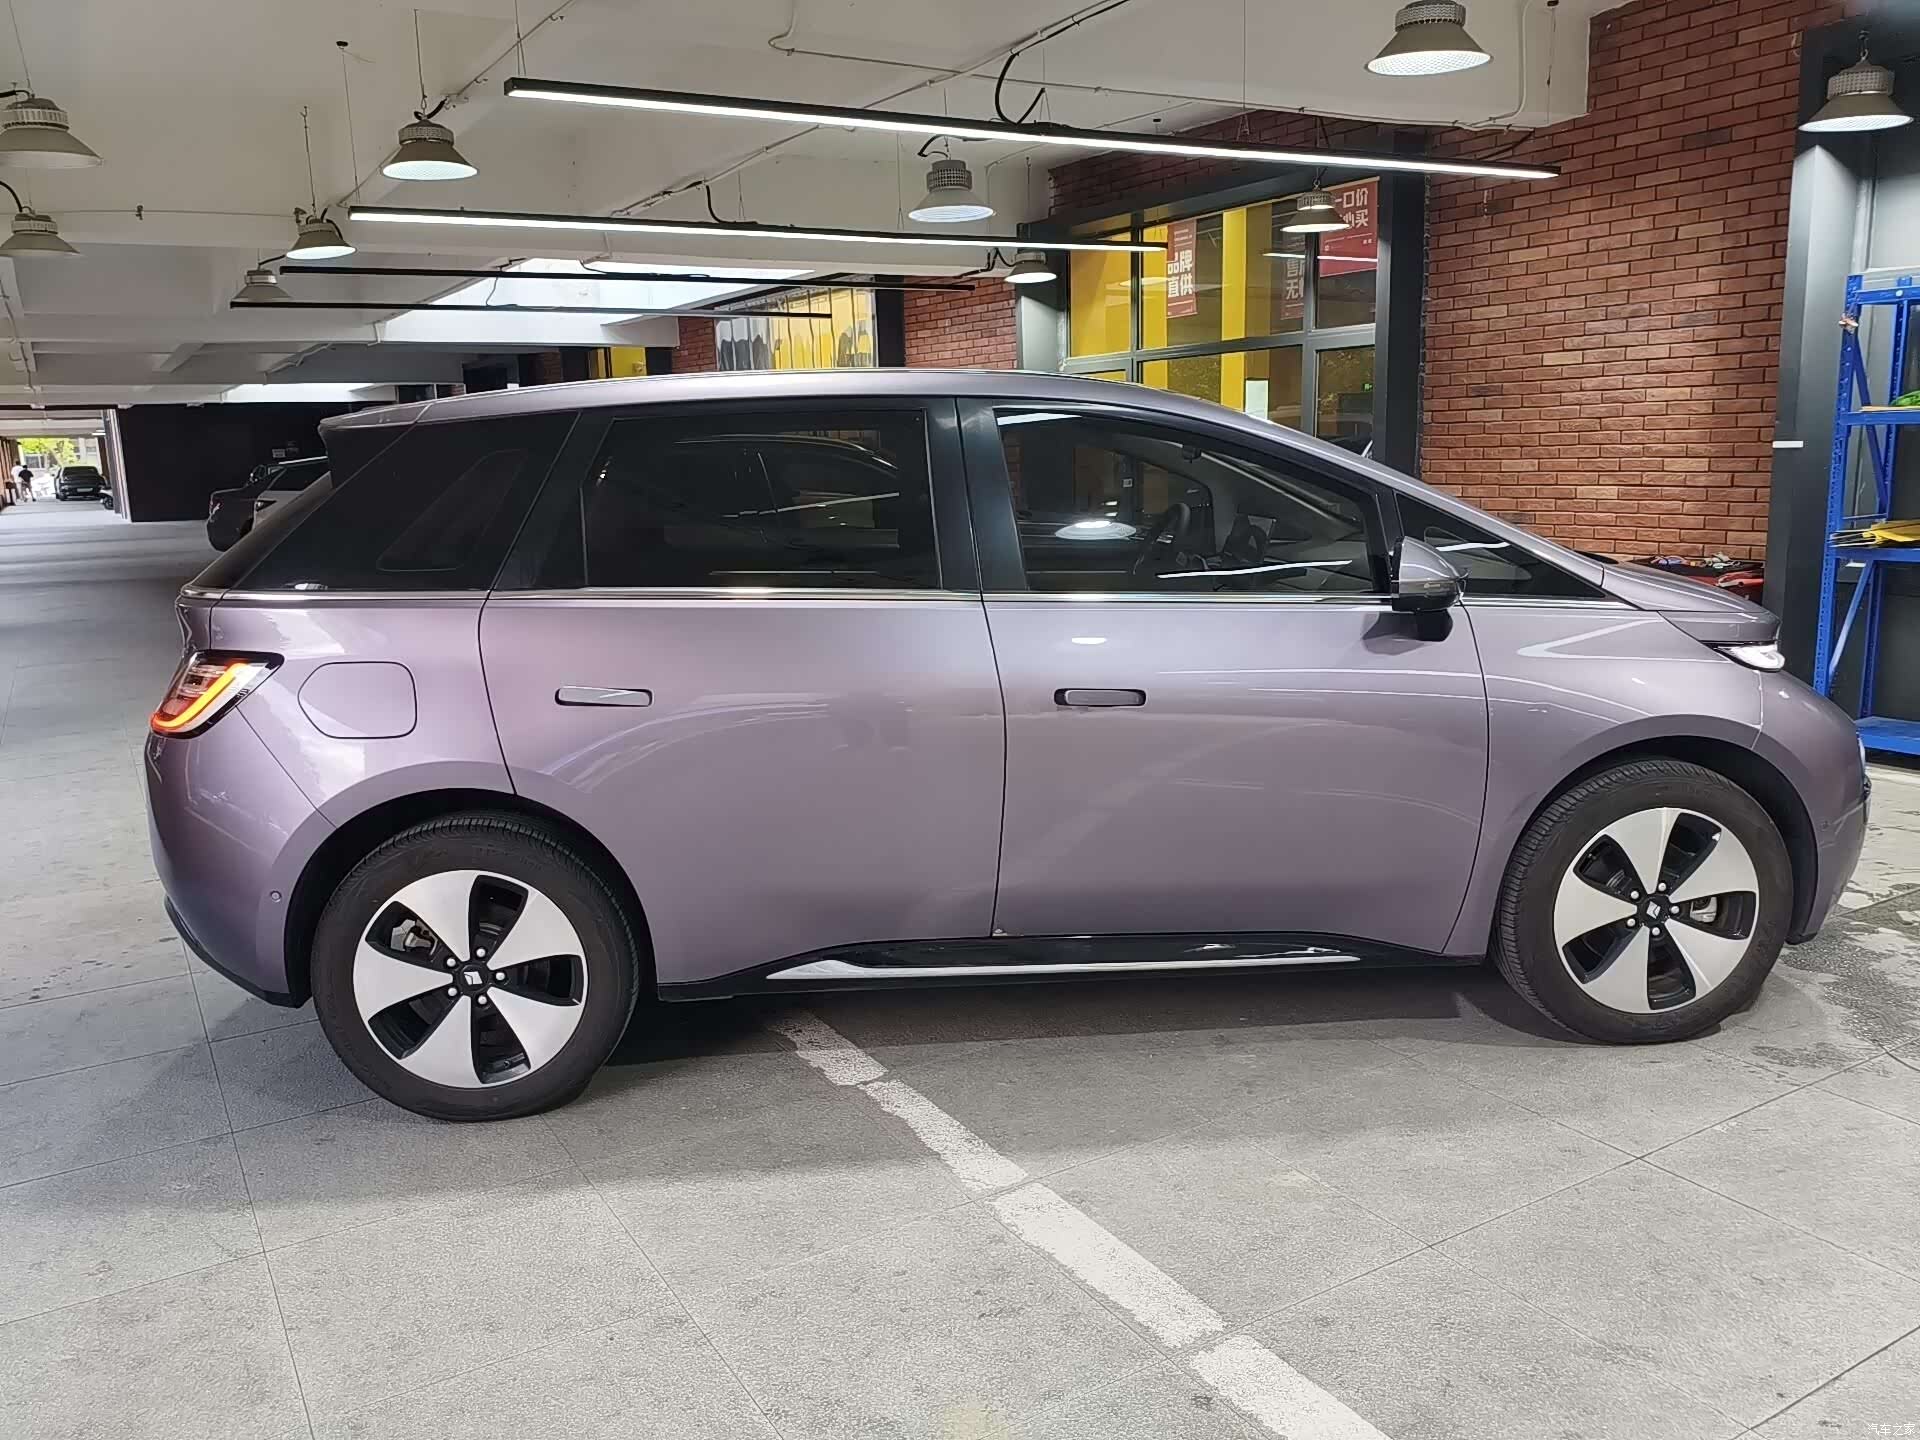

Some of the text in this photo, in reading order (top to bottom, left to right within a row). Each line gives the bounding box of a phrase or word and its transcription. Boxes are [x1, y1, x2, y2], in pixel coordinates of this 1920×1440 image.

[1334, 187, 1369, 209] 一口价
[1339, 208, 1369, 230] 心买
[1167, 249, 1193, 275] 品牌
[1167, 272, 1193, 298] 直供
